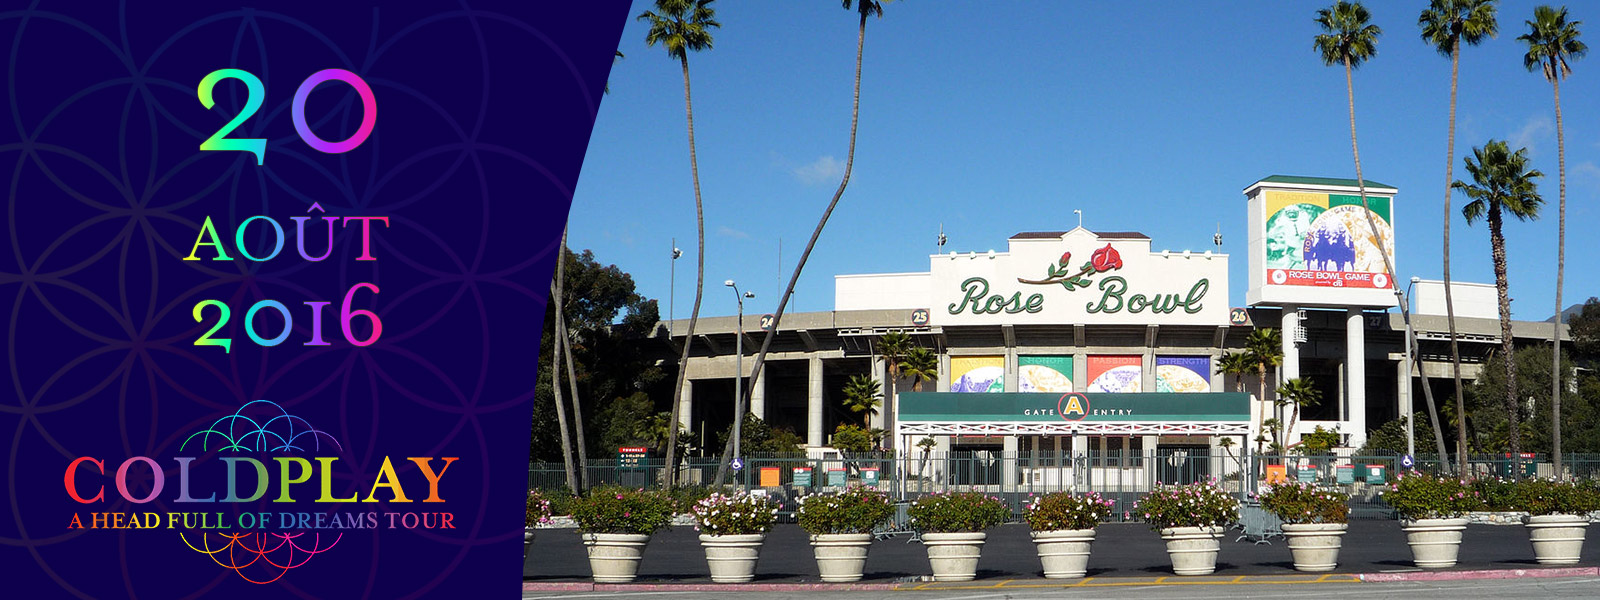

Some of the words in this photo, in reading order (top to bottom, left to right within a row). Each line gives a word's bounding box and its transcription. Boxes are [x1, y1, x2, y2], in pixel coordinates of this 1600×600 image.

[1289, 270, 1314, 279] ROSE
[1316, 271, 1343, 280] BOWL
[1345, 273, 1371, 282] GAME
[948, 276, 1044, 315] Rose
[1085, 275, 1210, 314] Bowl
[913, 312, 928, 323] 25
[1231, 311, 1246, 322] 26
[1159, 357, 1208, 365] STRENGTH
[1064, 395, 1084, 416] A
